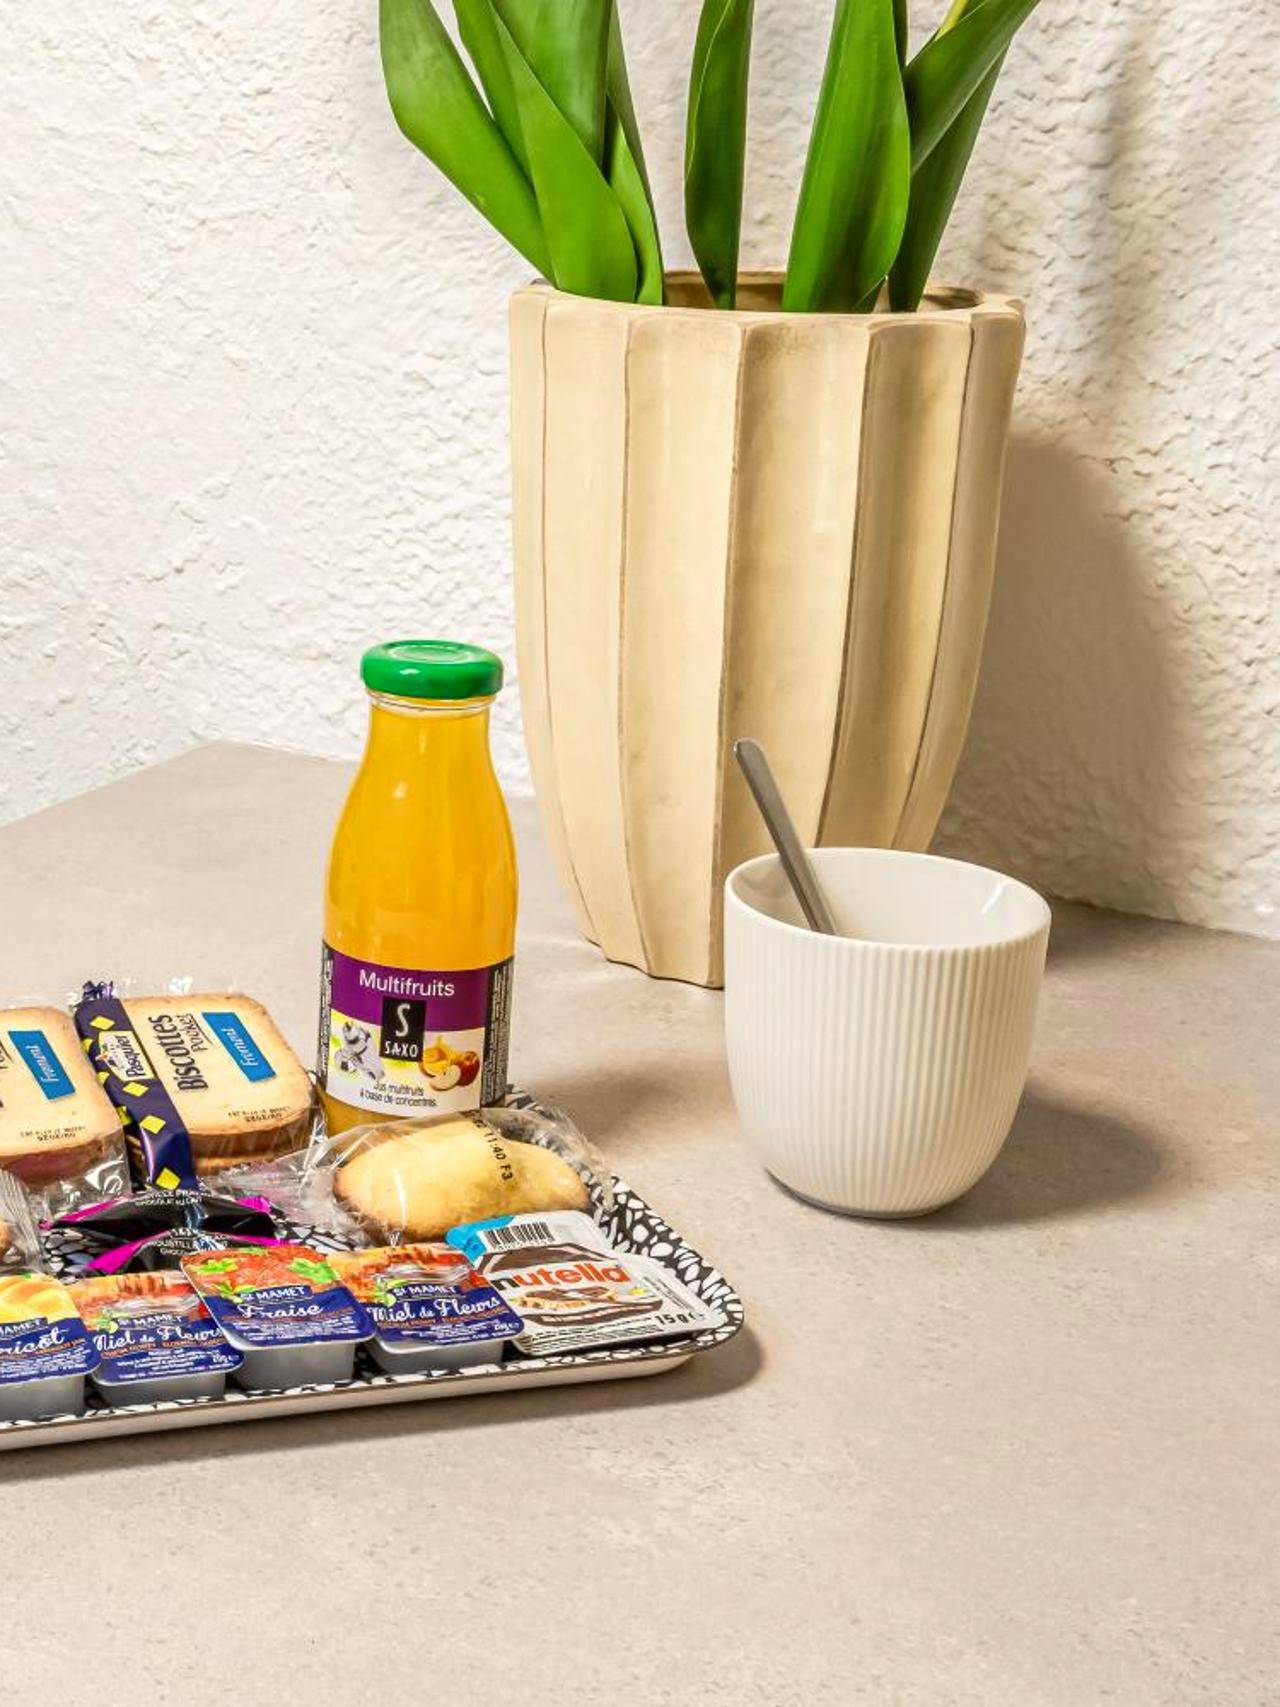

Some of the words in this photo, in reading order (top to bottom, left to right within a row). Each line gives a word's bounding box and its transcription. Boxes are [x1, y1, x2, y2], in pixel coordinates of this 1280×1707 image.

[359, 969, 456, 997] Multifruits
[395, 1003, 411, 1037] S
[115, 1035, 146, 1078] Pasquier
[148, 1014, 209, 1091] Biscottes
[384, 1041, 419, 1058] SAXO
[500, 1164, 513, 1180] F3
[492, 1263, 631, 1291] nutella
[256, 1286, 305, 1300] MAMET
[411, 1285, 457, 1295] MAMET
[237, 1304, 323, 1318] Fraise
[366, 1303, 416, 1322] Miel
[419, 1307, 435, 1317] de
[433, 1296, 500, 1316] Fleurs
[140, 1334, 155, 1343] de
